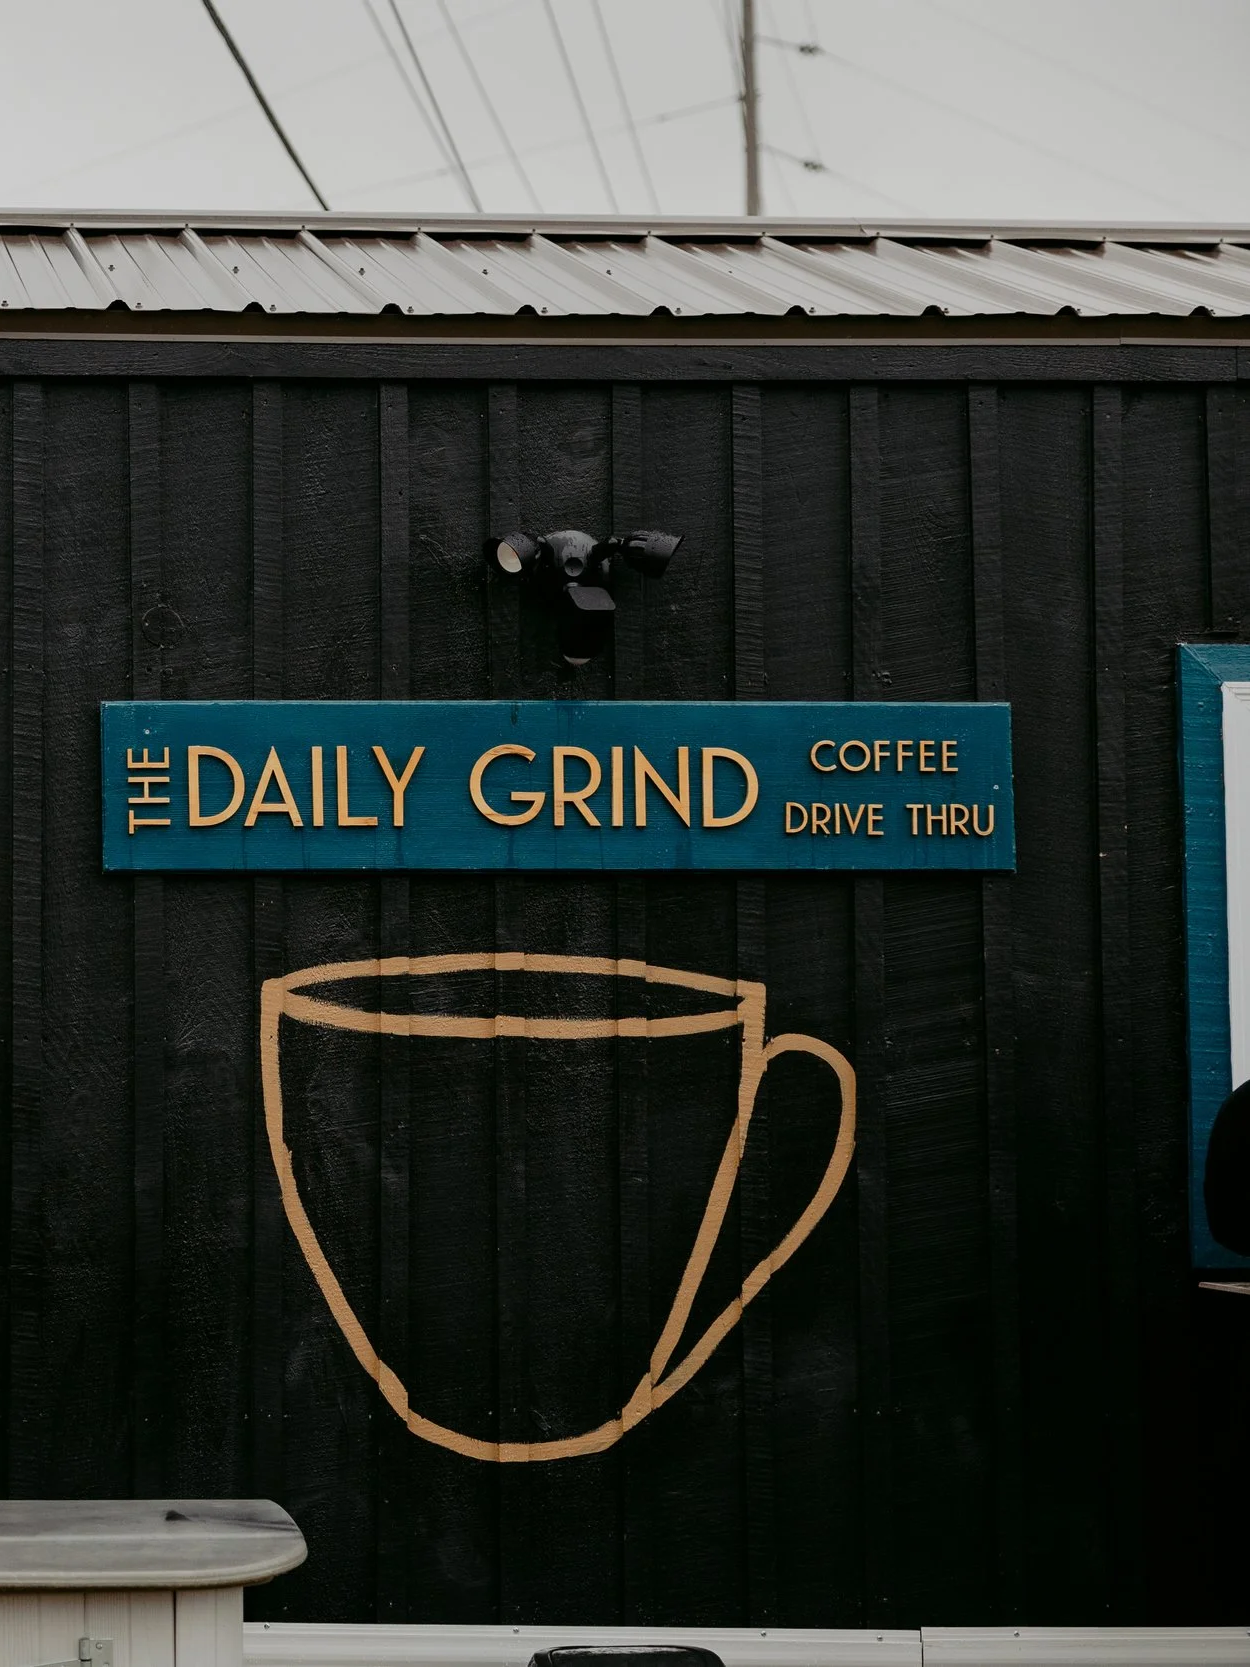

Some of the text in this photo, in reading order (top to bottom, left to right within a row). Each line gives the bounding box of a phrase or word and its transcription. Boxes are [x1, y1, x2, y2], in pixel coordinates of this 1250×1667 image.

[187, 743, 759, 828] DAILY GRIND
[810, 739, 959, 772] COFFEE
[127, 746, 171, 834] THE
[785, 801, 995, 837] DRIVE THRU
